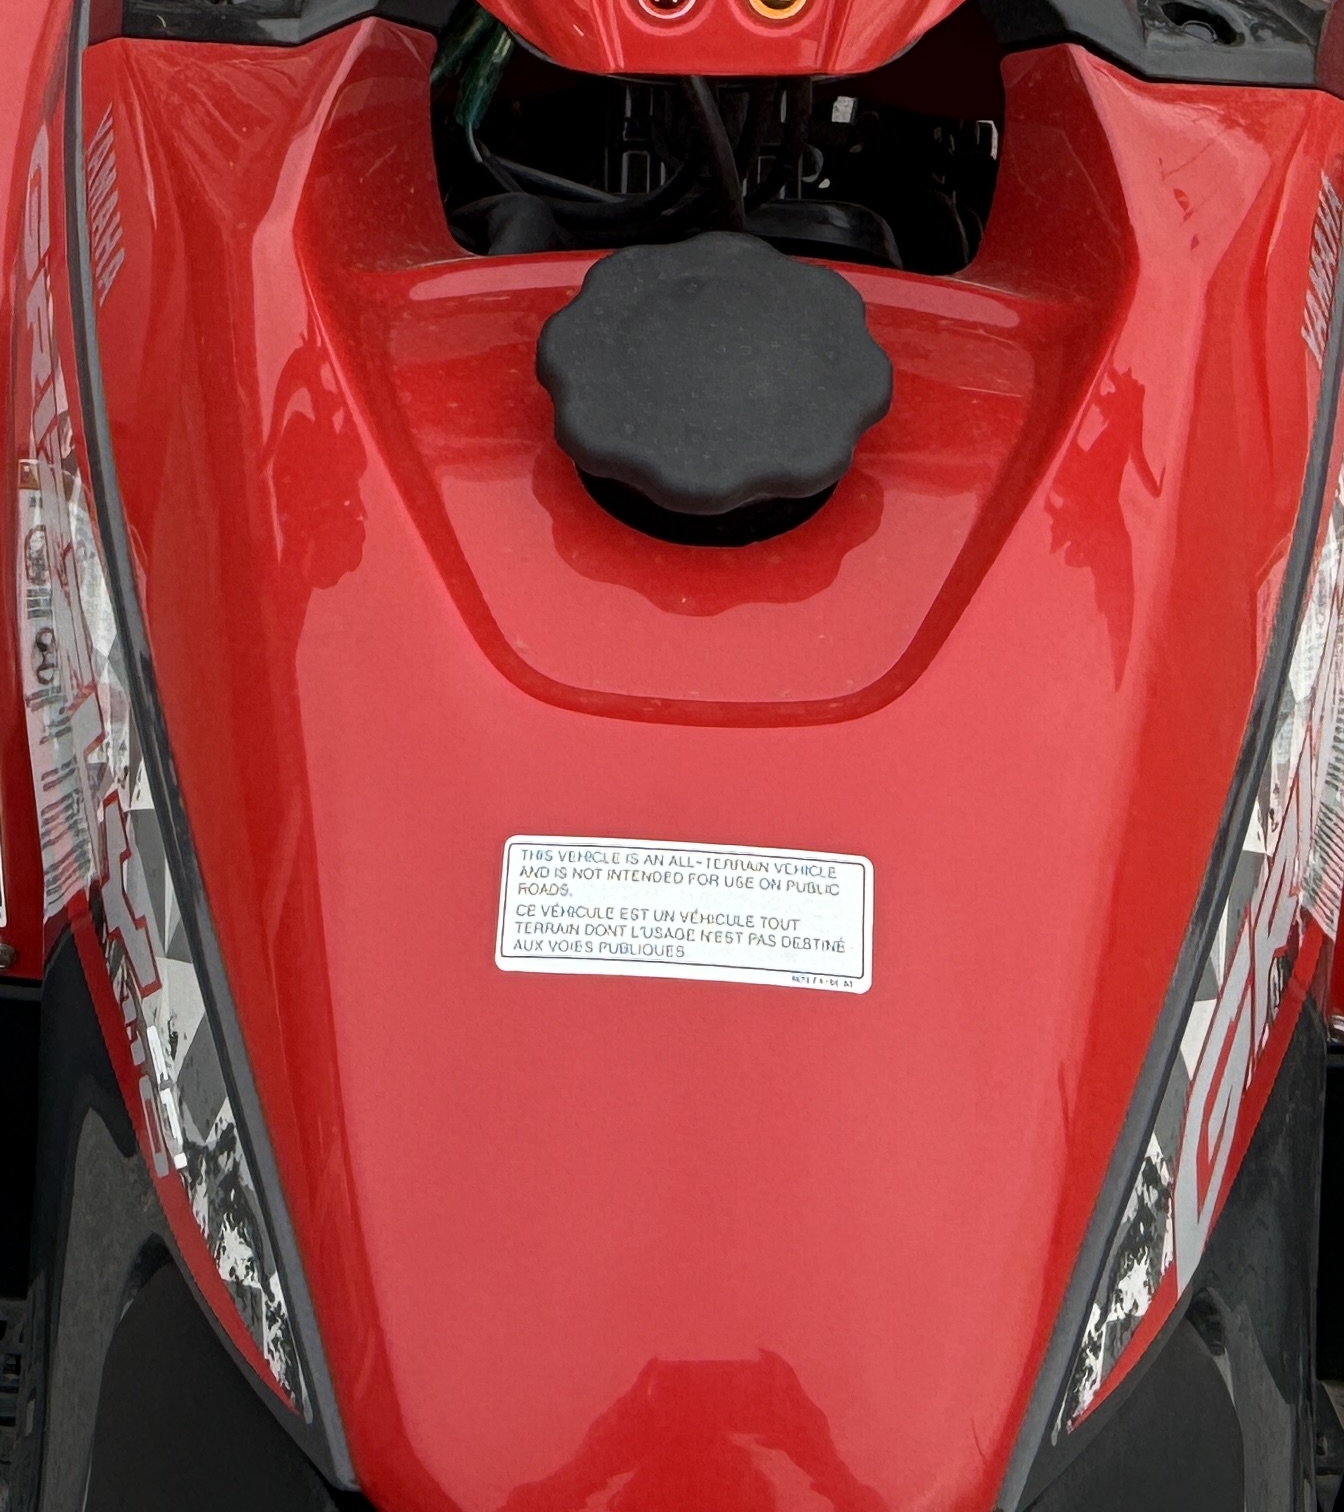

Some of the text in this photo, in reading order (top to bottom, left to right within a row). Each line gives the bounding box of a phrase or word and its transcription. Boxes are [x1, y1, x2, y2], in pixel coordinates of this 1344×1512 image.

[521, 849, 554, 862] THIS
[557, 850, 621, 865] VEHICLE
[625, 852, 640, 865] IS
[643, 854, 664, 867] AN
[773, 862, 837, 880] VEHICLE
[517, 882, 573, 897] ROADS.
[519, 865, 840, 897] AND IS NOT INTENDED FOR USE ON PUBLIC
[515, 903, 536, 917] CE
[619, 907, 650, 922] EST
[653, 909, 676, 923] UN
[759, 915, 801, 932] TOUT
[513, 938, 544, 952] AUX
[548, 939, 594, 954] VOIES
[514, 920, 580, 936] TERRAIN
[584, 923, 628, 937] DONT
[748, 932, 777, 948] PAS
